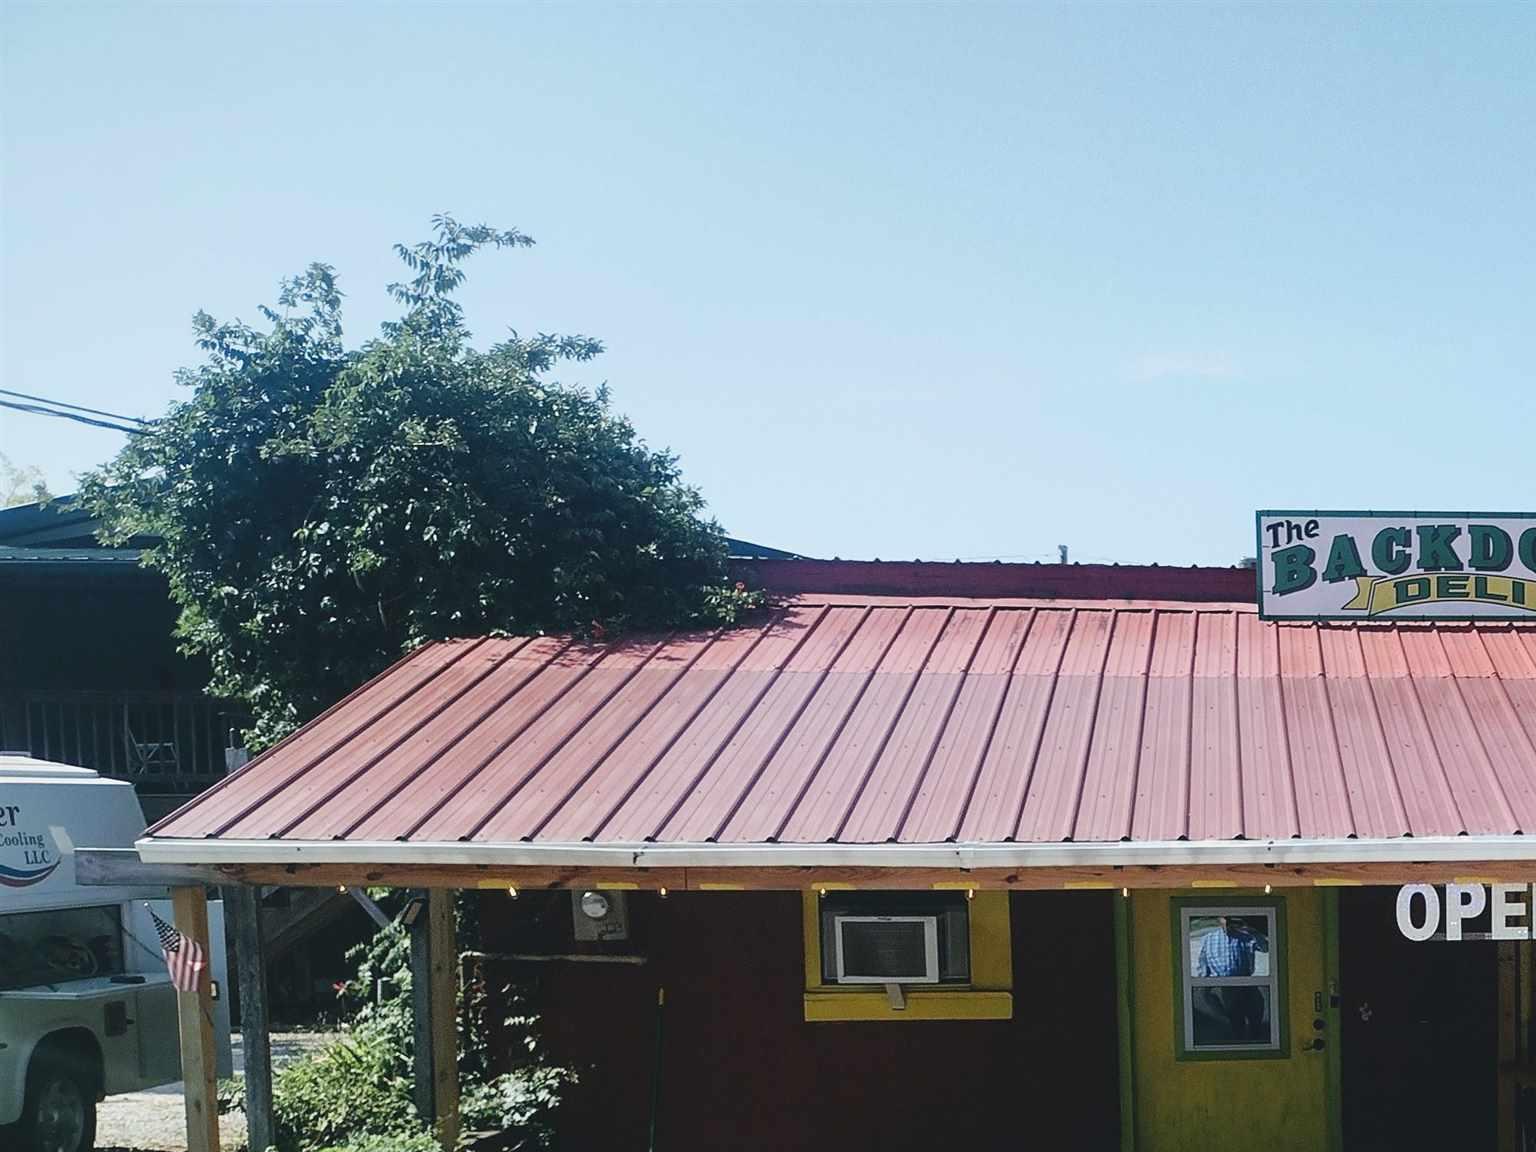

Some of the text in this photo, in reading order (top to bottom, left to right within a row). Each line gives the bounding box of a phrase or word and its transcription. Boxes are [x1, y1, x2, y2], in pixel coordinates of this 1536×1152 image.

[1266, 519, 1320, 549] The
[1392, 575, 1526, 605] DELI
[24, 849, 51, 865] LLC
